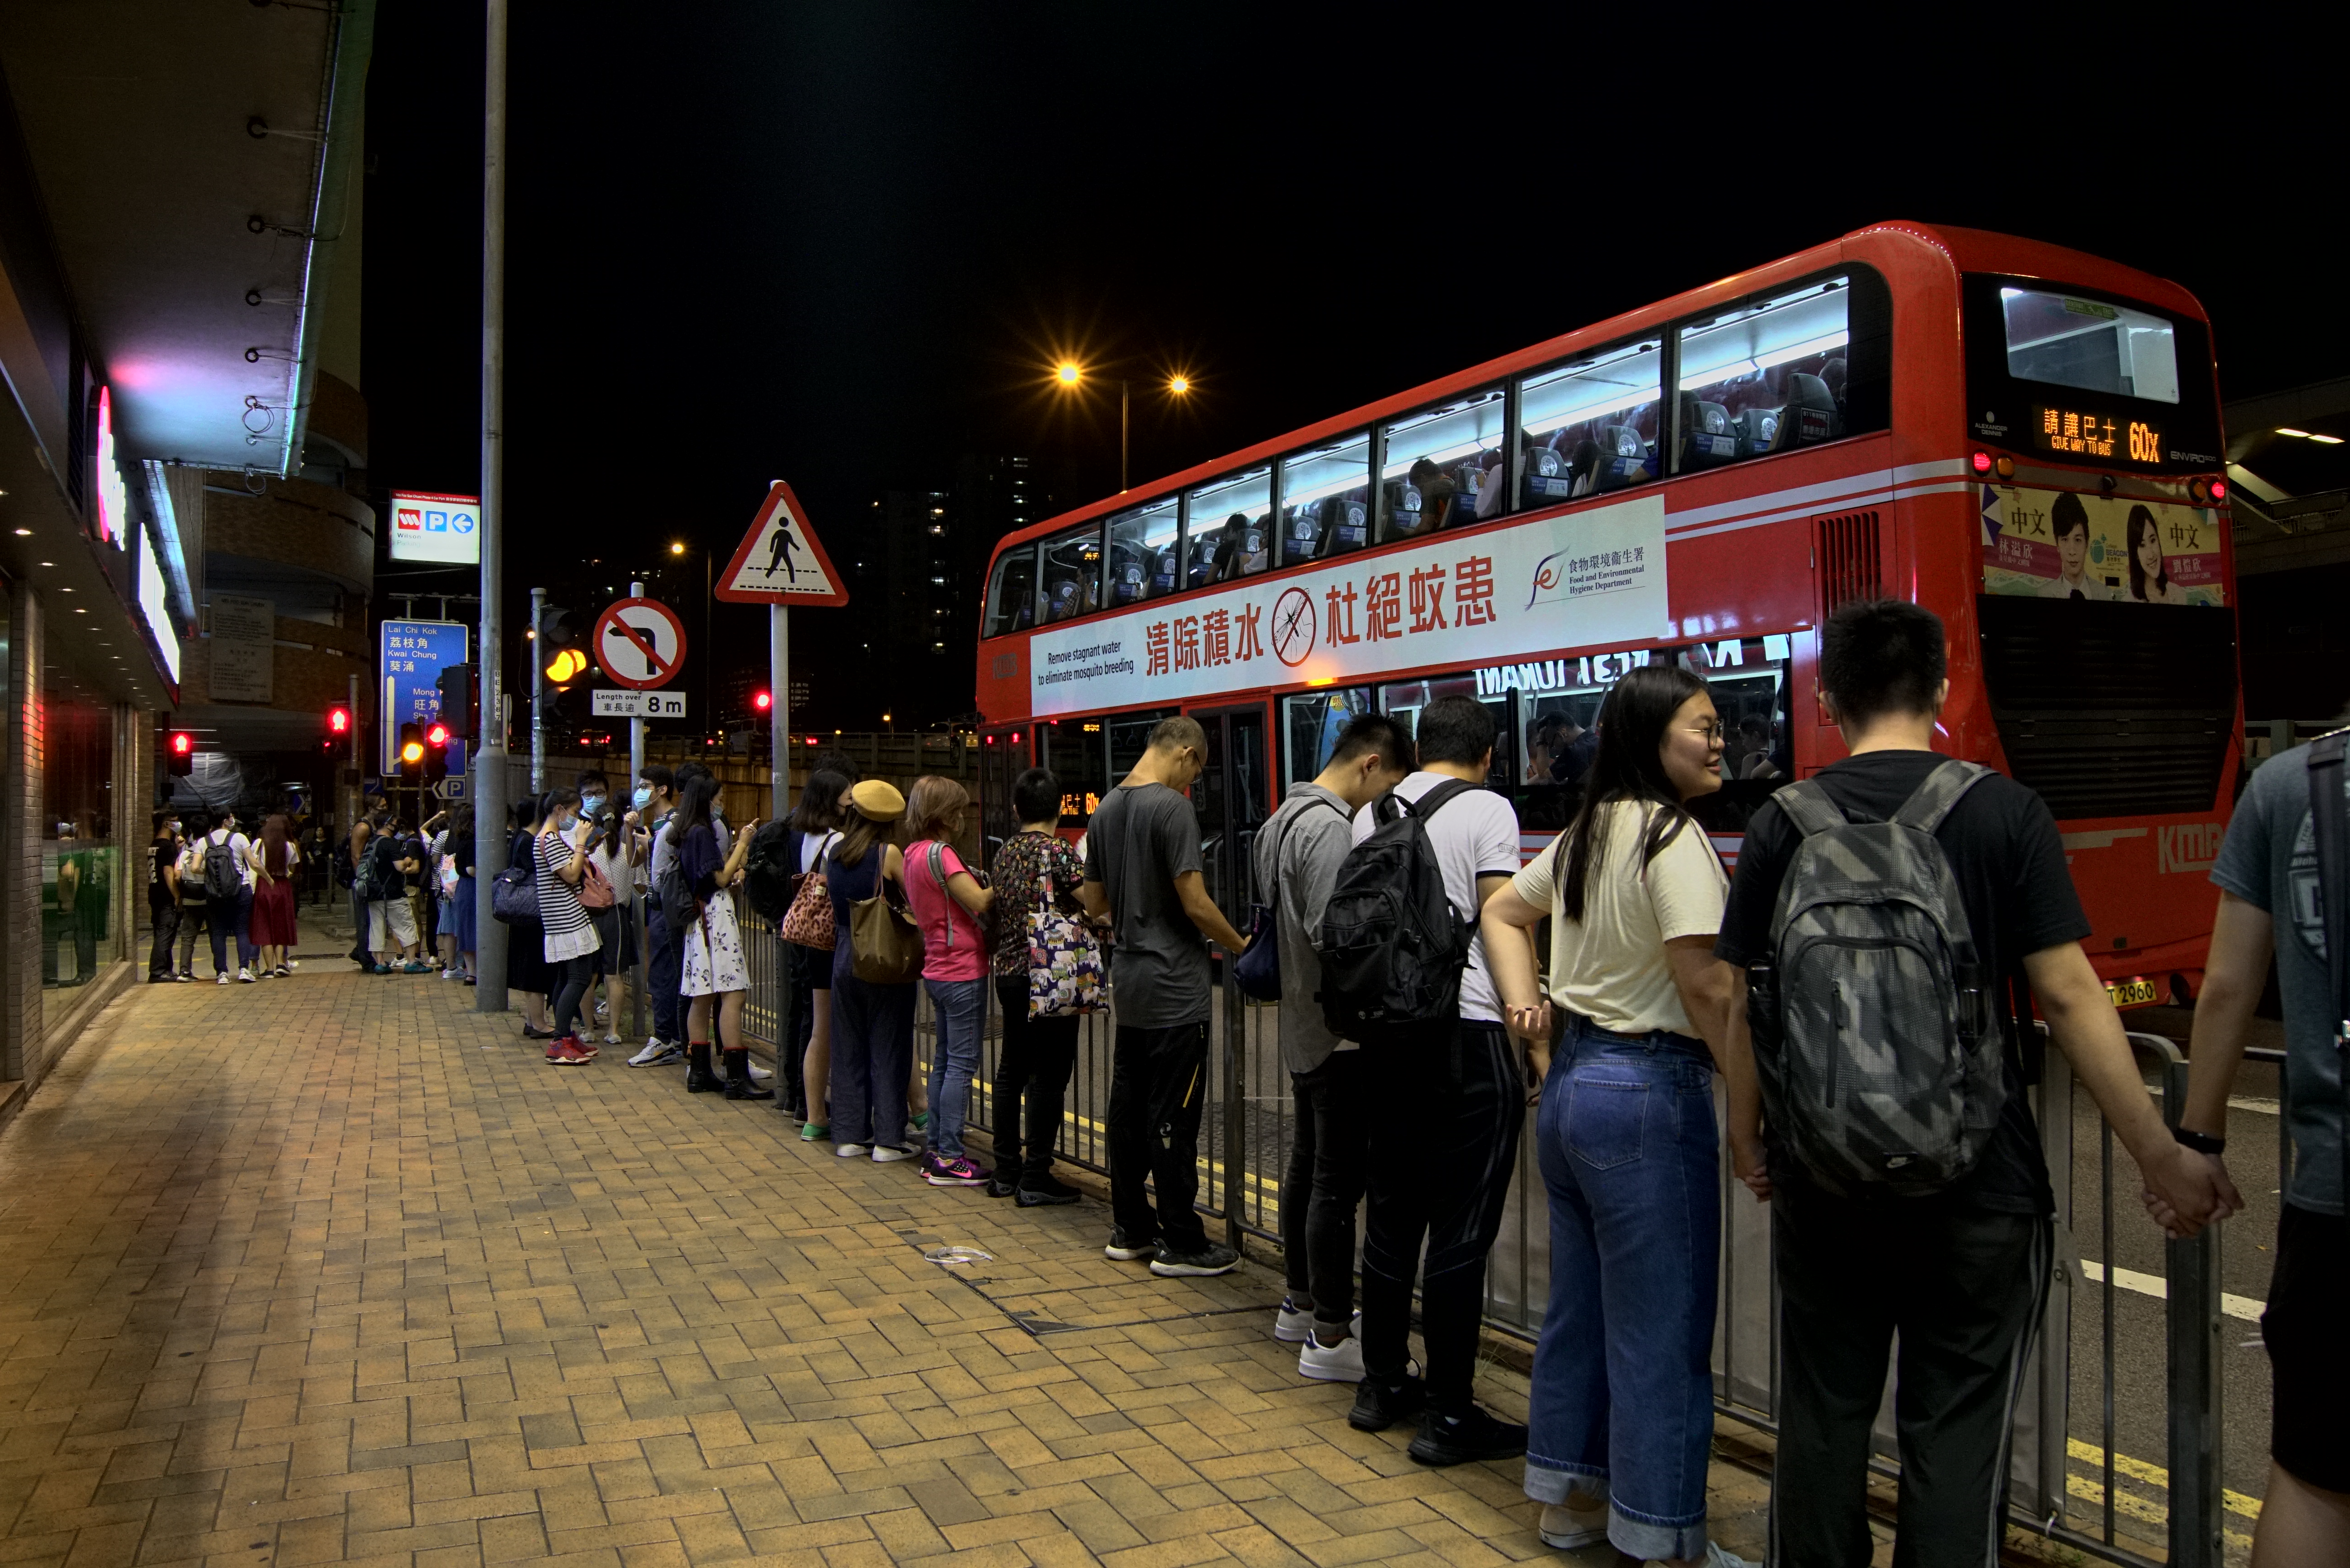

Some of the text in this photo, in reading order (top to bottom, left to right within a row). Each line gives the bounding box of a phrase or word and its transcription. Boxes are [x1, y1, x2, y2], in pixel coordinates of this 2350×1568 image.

[1975, 422, 2008, 432] ALEXANDER
[2052, 436, 2111, 456] GIVE WAY TO BUS
[429, 513, 444, 530] P
[2011, 507, 2046, 536] 中文
[2169, 523, 2199, 549] 中文
[2106, 549, 2128, 557] BEACON
[1569, 564, 1644, 584] Food and Environmental
[1570, 578, 1632, 595] Hygiene Department
[1326, 555, 1496, 648] 杜絕蚊患
[389, 637, 427, 649] 荔枝角
[1146, 603, 1264, 677] 清除積水
[388, 649, 437, 660] Kwai Chung
[1048, 641, 1121, 665] Remove stagnant water
[389, 660, 414, 672] 葵涌
[1038, 658, 1134, 686] to eliminate mosquito breeding
[413, 688, 435, 697] Mong
[414, 699, 439, 710] 旺角
[603, 703, 635, 712] 車長逾
[648, 696, 682, 713] 8 m
[450, 782, 461, 795] P
[2119, 983, 2154, 1004] 2960
